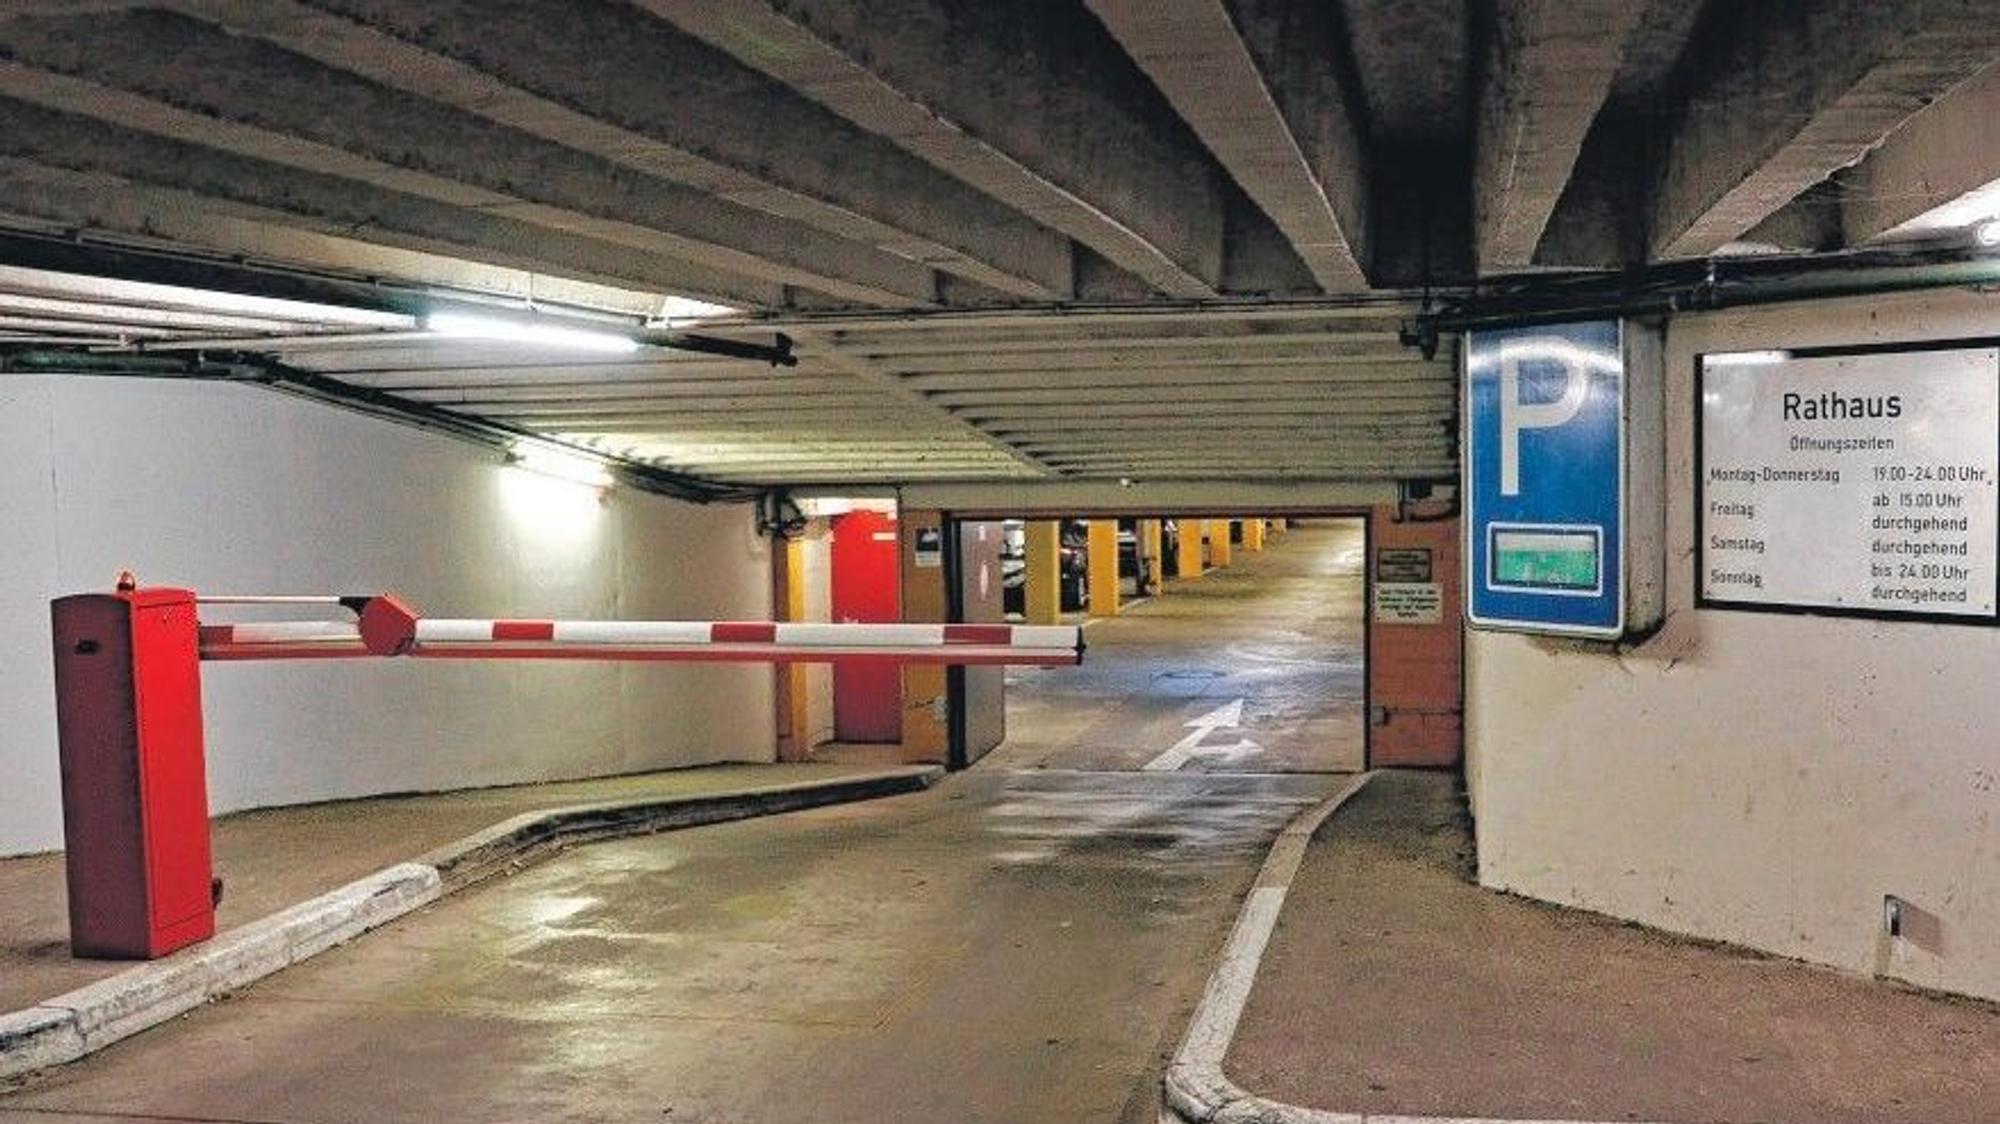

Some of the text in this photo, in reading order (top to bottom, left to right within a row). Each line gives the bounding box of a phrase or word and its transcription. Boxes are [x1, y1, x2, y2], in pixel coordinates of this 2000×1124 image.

[1784, 392, 1901, 420] Rathaus
[1500, 335, 1586, 495] P
[1710, 468, 1840, 484] Montag-Donnerstag
[1873, 494, 1889, 507] ab
[1937, 494, 1962, 508] Uhr
[1711, 503, 1754, 518] Freitag
[1872, 516, 1967, 533] durchgehend
[1711, 536, 1764, 553] Samstag
[1872, 541, 1967, 558] durchgehend
[1872, 563, 1891, 577] bis
[1944, 565, 1970, 580] Uhr
[1872, 586, 1966, 603] durchgehend
